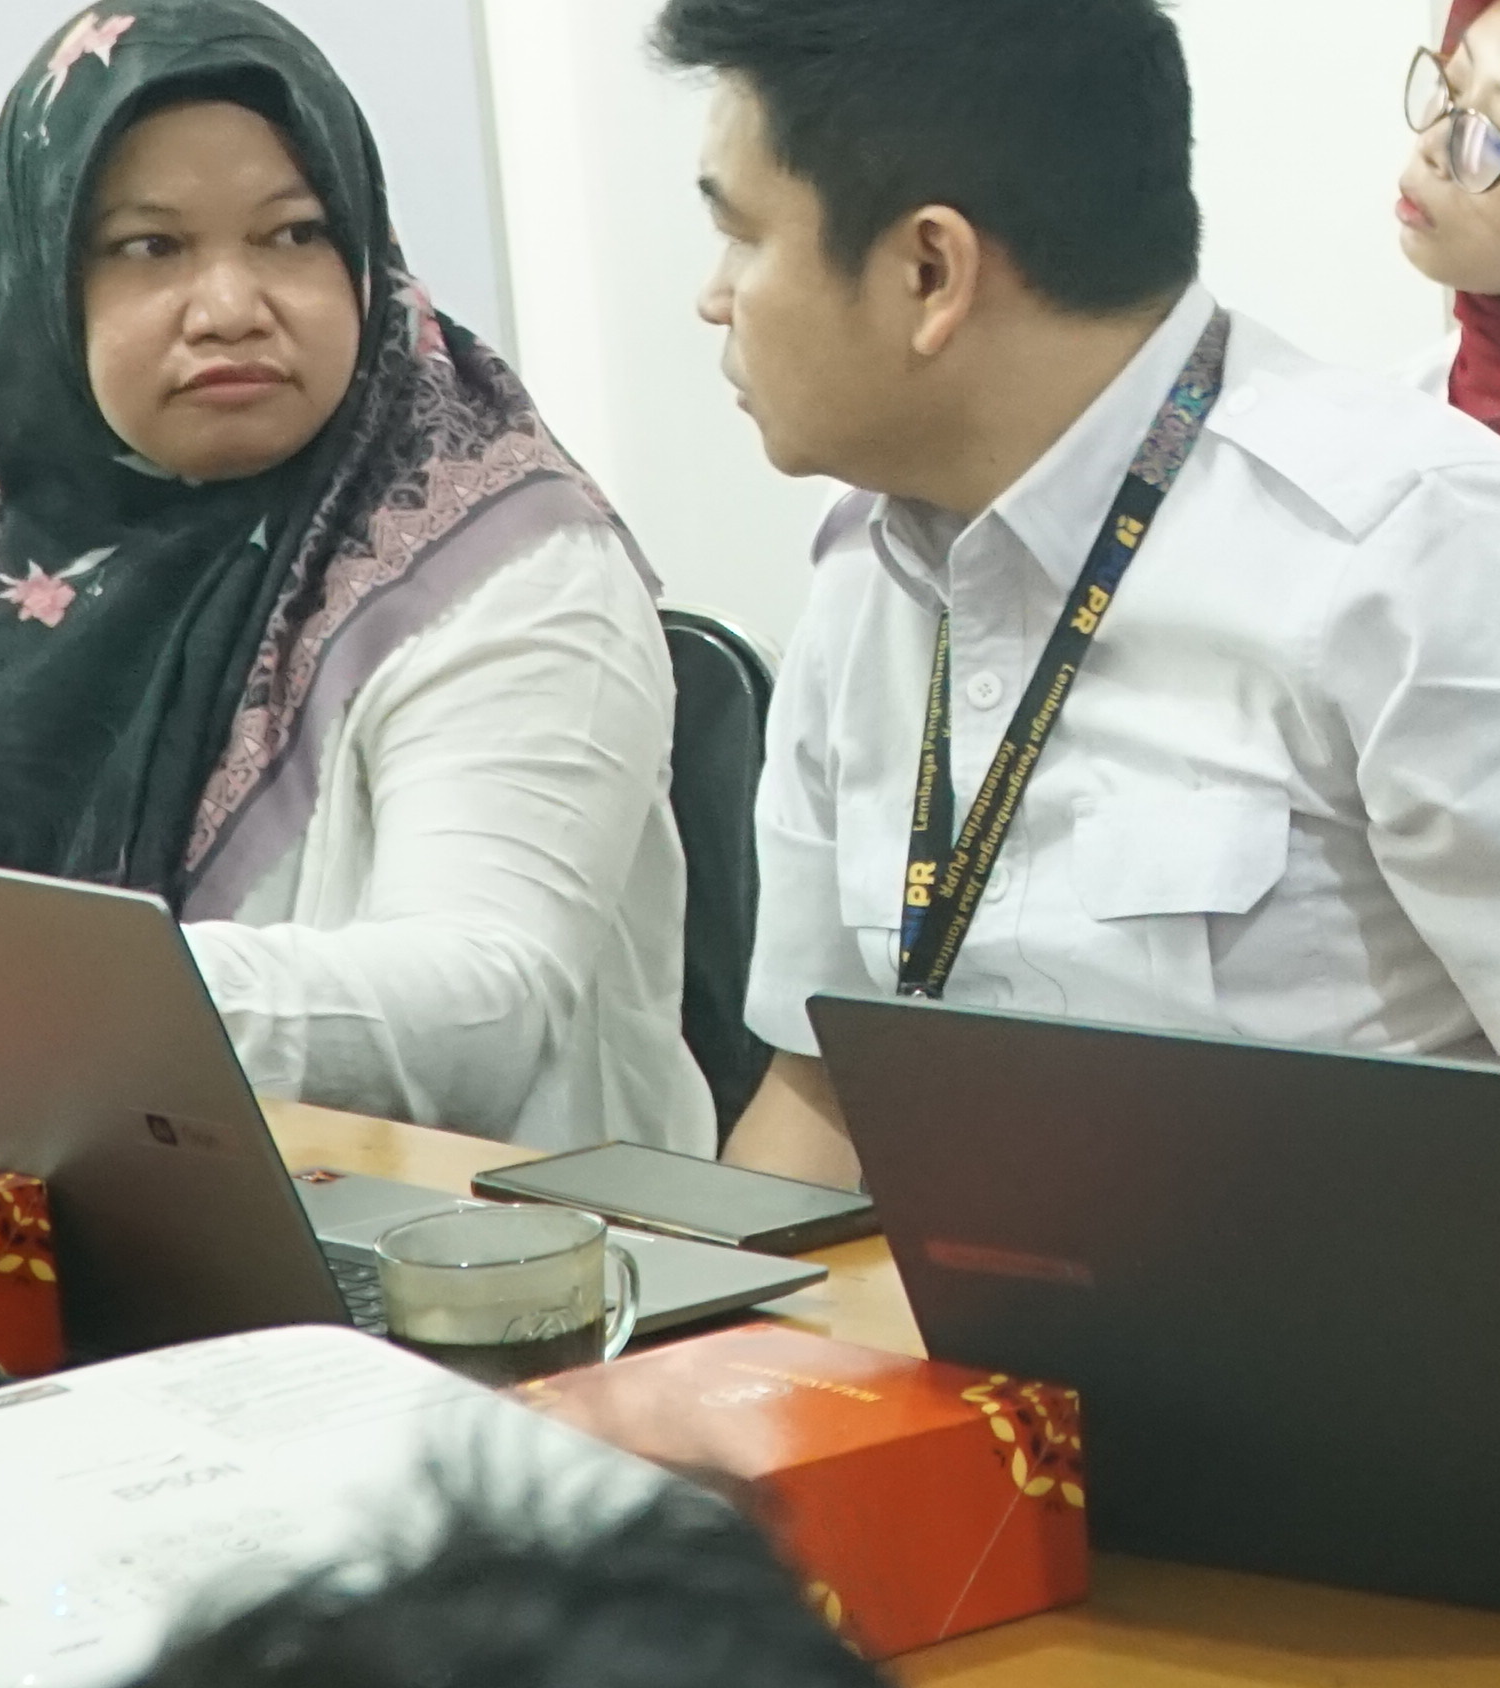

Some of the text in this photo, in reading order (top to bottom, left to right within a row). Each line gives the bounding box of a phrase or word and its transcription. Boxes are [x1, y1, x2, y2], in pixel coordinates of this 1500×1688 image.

[1029, 664, 1076, 742] Lembaga
[912, 753, 938, 831] Lembaga
[938, 740, 1017, 899] Kementerian PUPR
[973, 744, 1040, 876] Pengembangan
[958, 875, 984, 914] Jasa
